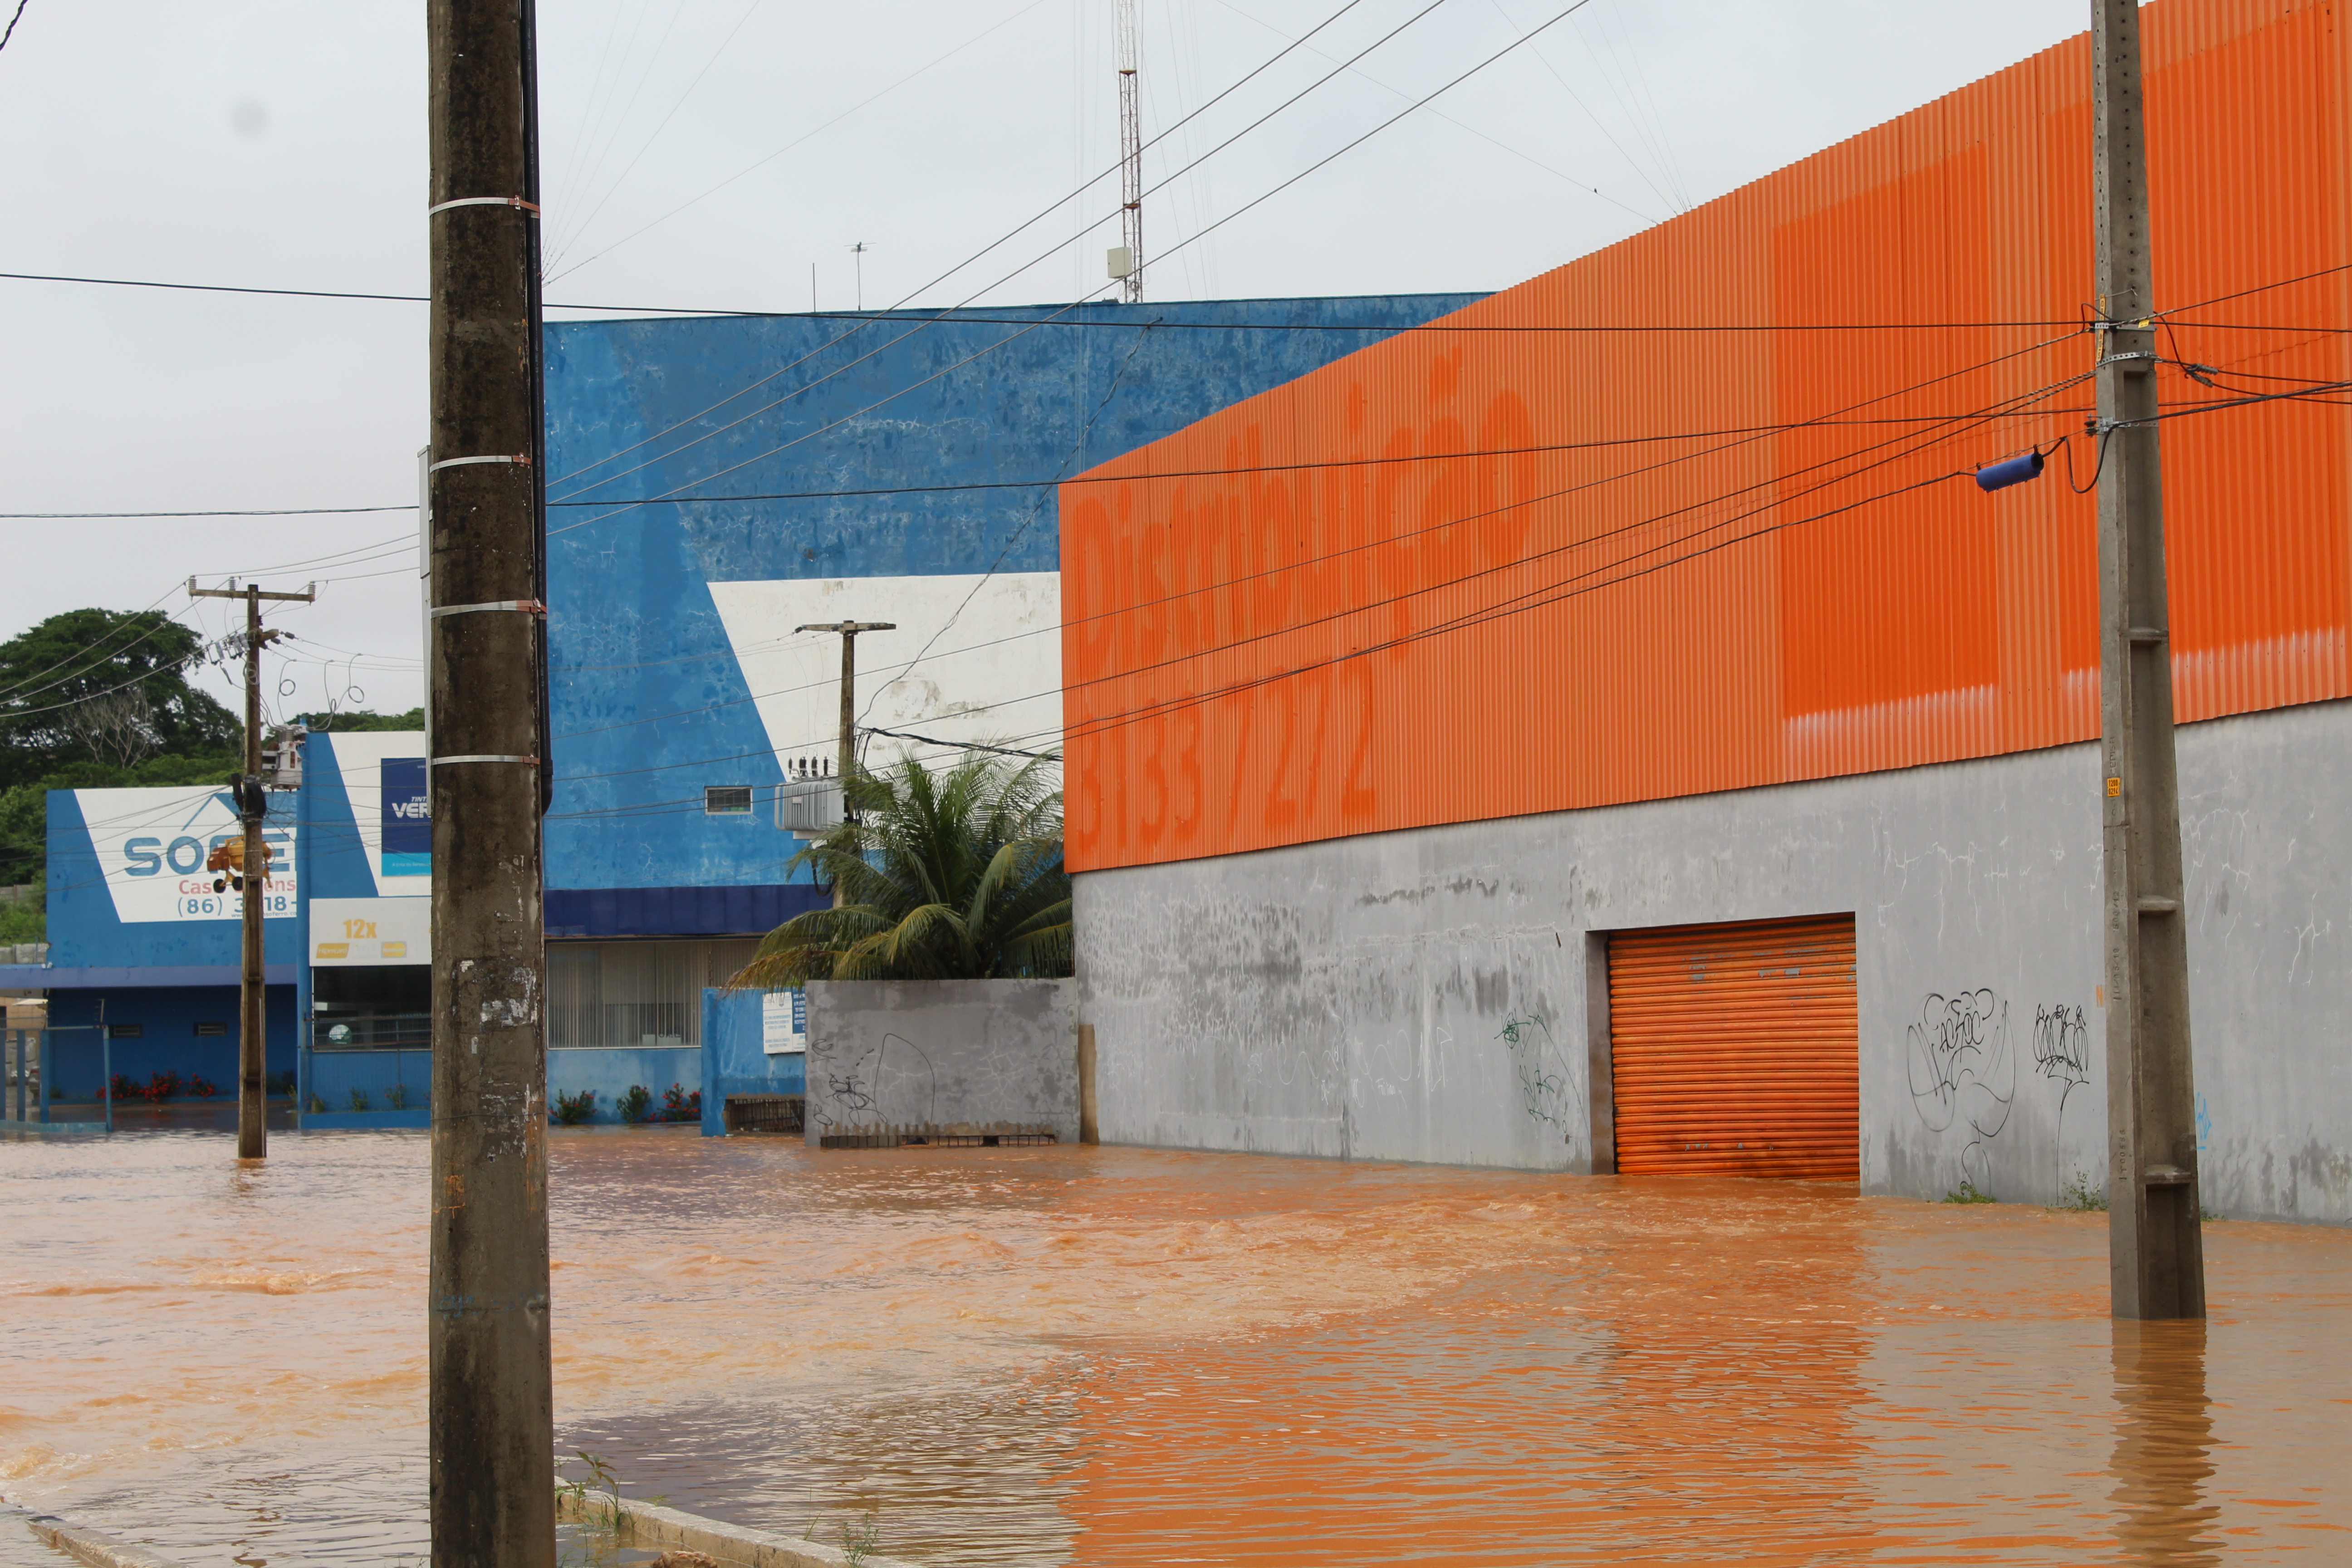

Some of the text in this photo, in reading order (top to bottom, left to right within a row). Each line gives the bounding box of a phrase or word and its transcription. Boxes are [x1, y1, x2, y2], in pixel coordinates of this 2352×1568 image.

[179, 879, 212, 894] Cas
[177, 896, 297, 917] (86) 318-
[343, 918, 377, 939] 12x
